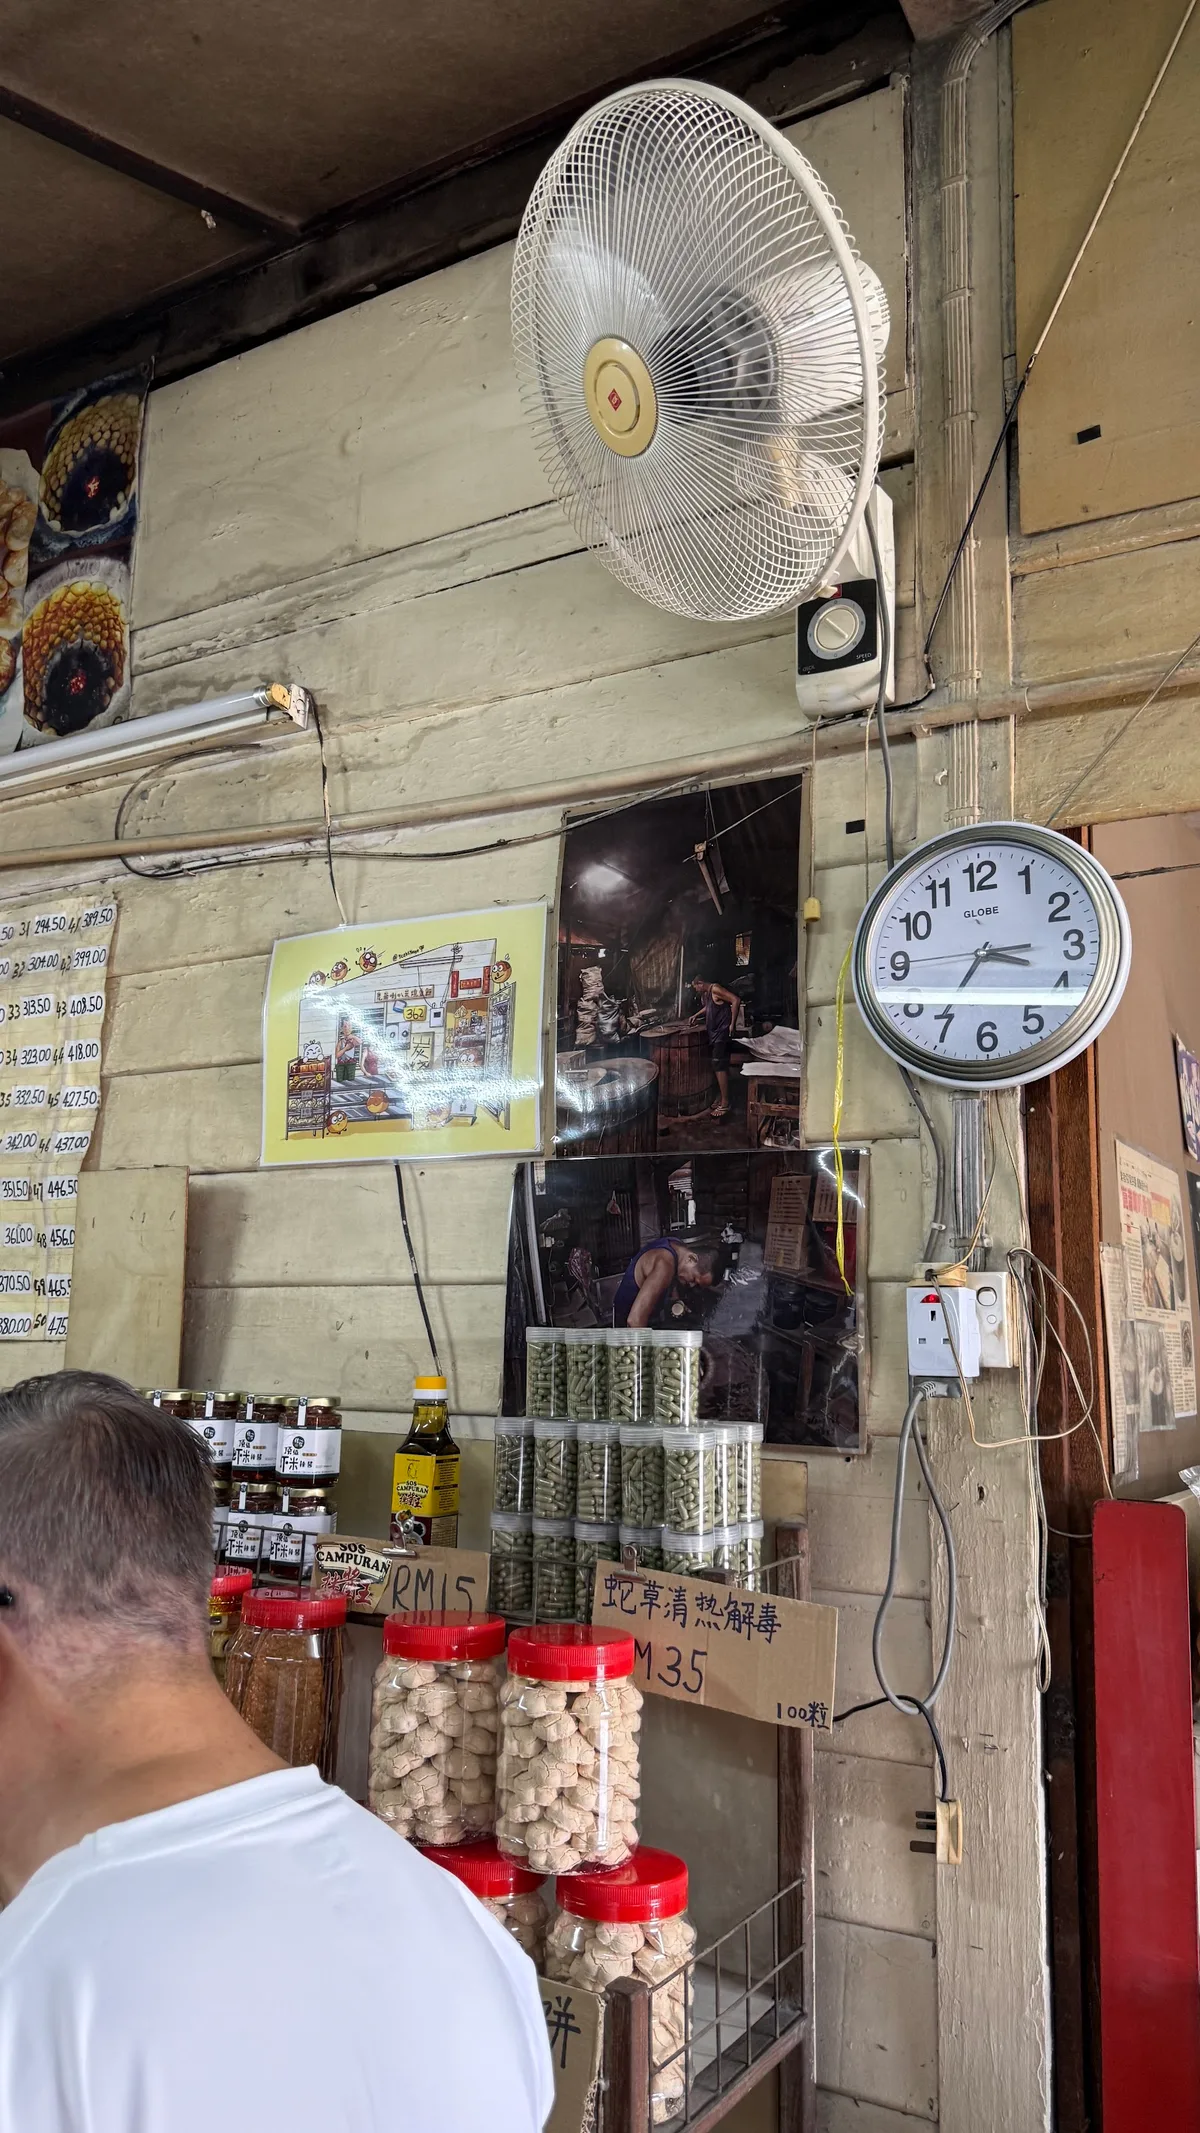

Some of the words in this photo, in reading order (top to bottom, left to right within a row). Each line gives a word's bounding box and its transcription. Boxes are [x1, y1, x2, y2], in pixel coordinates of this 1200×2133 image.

[856, 652, 872, 660] SPEED
[962, 860, 998, 892] 12
[1017, 864, 1031, 895] 1
[925, 877, 951, 909] 11
[1048, 891, 1071, 923] 2
[19, 922, 30, 937] 31
[34, 916, 67, 935] 294.50
[68, 917, 81, 934] 41
[82, 908, 114, 929] 389.50
[899, 910, 932, 941] 10
[963, 906, 999, 919] GLOBE
[1062, 928, 1086, 960] 3
[12, 962, 25, 979] 32
[28, 953, 59, 972] 304.00
[60, 956, 71, 976] 42
[73, 948, 107, 968] 399.00
[889, 950, 910, 981] 9
[8, 1005, 21, 1019] 33
[23, 997, 51, 1016] 313.50
[56, 1001, 67, 1019] 43
[70, 995, 103, 1016] 408.50
[406, 1008, 424, 1019] 362
[1022, 1000, 1045, 1035] 5
[934, 1012, 955, 1043] 7
[976, 1021, 999, 1053] 6
[6, 1049, 18, 1066] 34
[20, 1048, 51, 1065] 323.00
[53, 1047, 64, 1066] 44
[67, 1043, 99, 1063] 418.00
[0, 1093, 12, 1107] 35
[14, 1089, 46, 1106] 332.50
[47, 1094, 61, 1108] 45
[63, 1090, 97, 1108] 427.50
[5, 1132, 38, 1151] 342.00
[39, 1138, 51, 1153] 46
[54, 1136, 89, 1152] 437.00
[2, 1180, 29, 1198] 351.50
[33, 1182, 44, 1202] 47
[4, 1226, 33, 1245] 361.00
[36, 1233, 47, 1249] 48
[50, 1229, 75, 1247] 456.0
[0, 1275, 31, 1293] 370.50
[34, 1278, 47, 1297] 49
[33, 1314, 47, 1329] 50
[48, 1316, 68, 1336] 475.
[396, 1485, 429, 1495] CAMPURAN
[316, 1551, 391, 1574] CAMPURAN
[339, 1542, 366, 1555] SOS
[602, 1574, 782, 1644] 蛇草清热解毒
[634, 1638, 708, 1694] M35
[777, 1701, 830, 1730] 100粒
